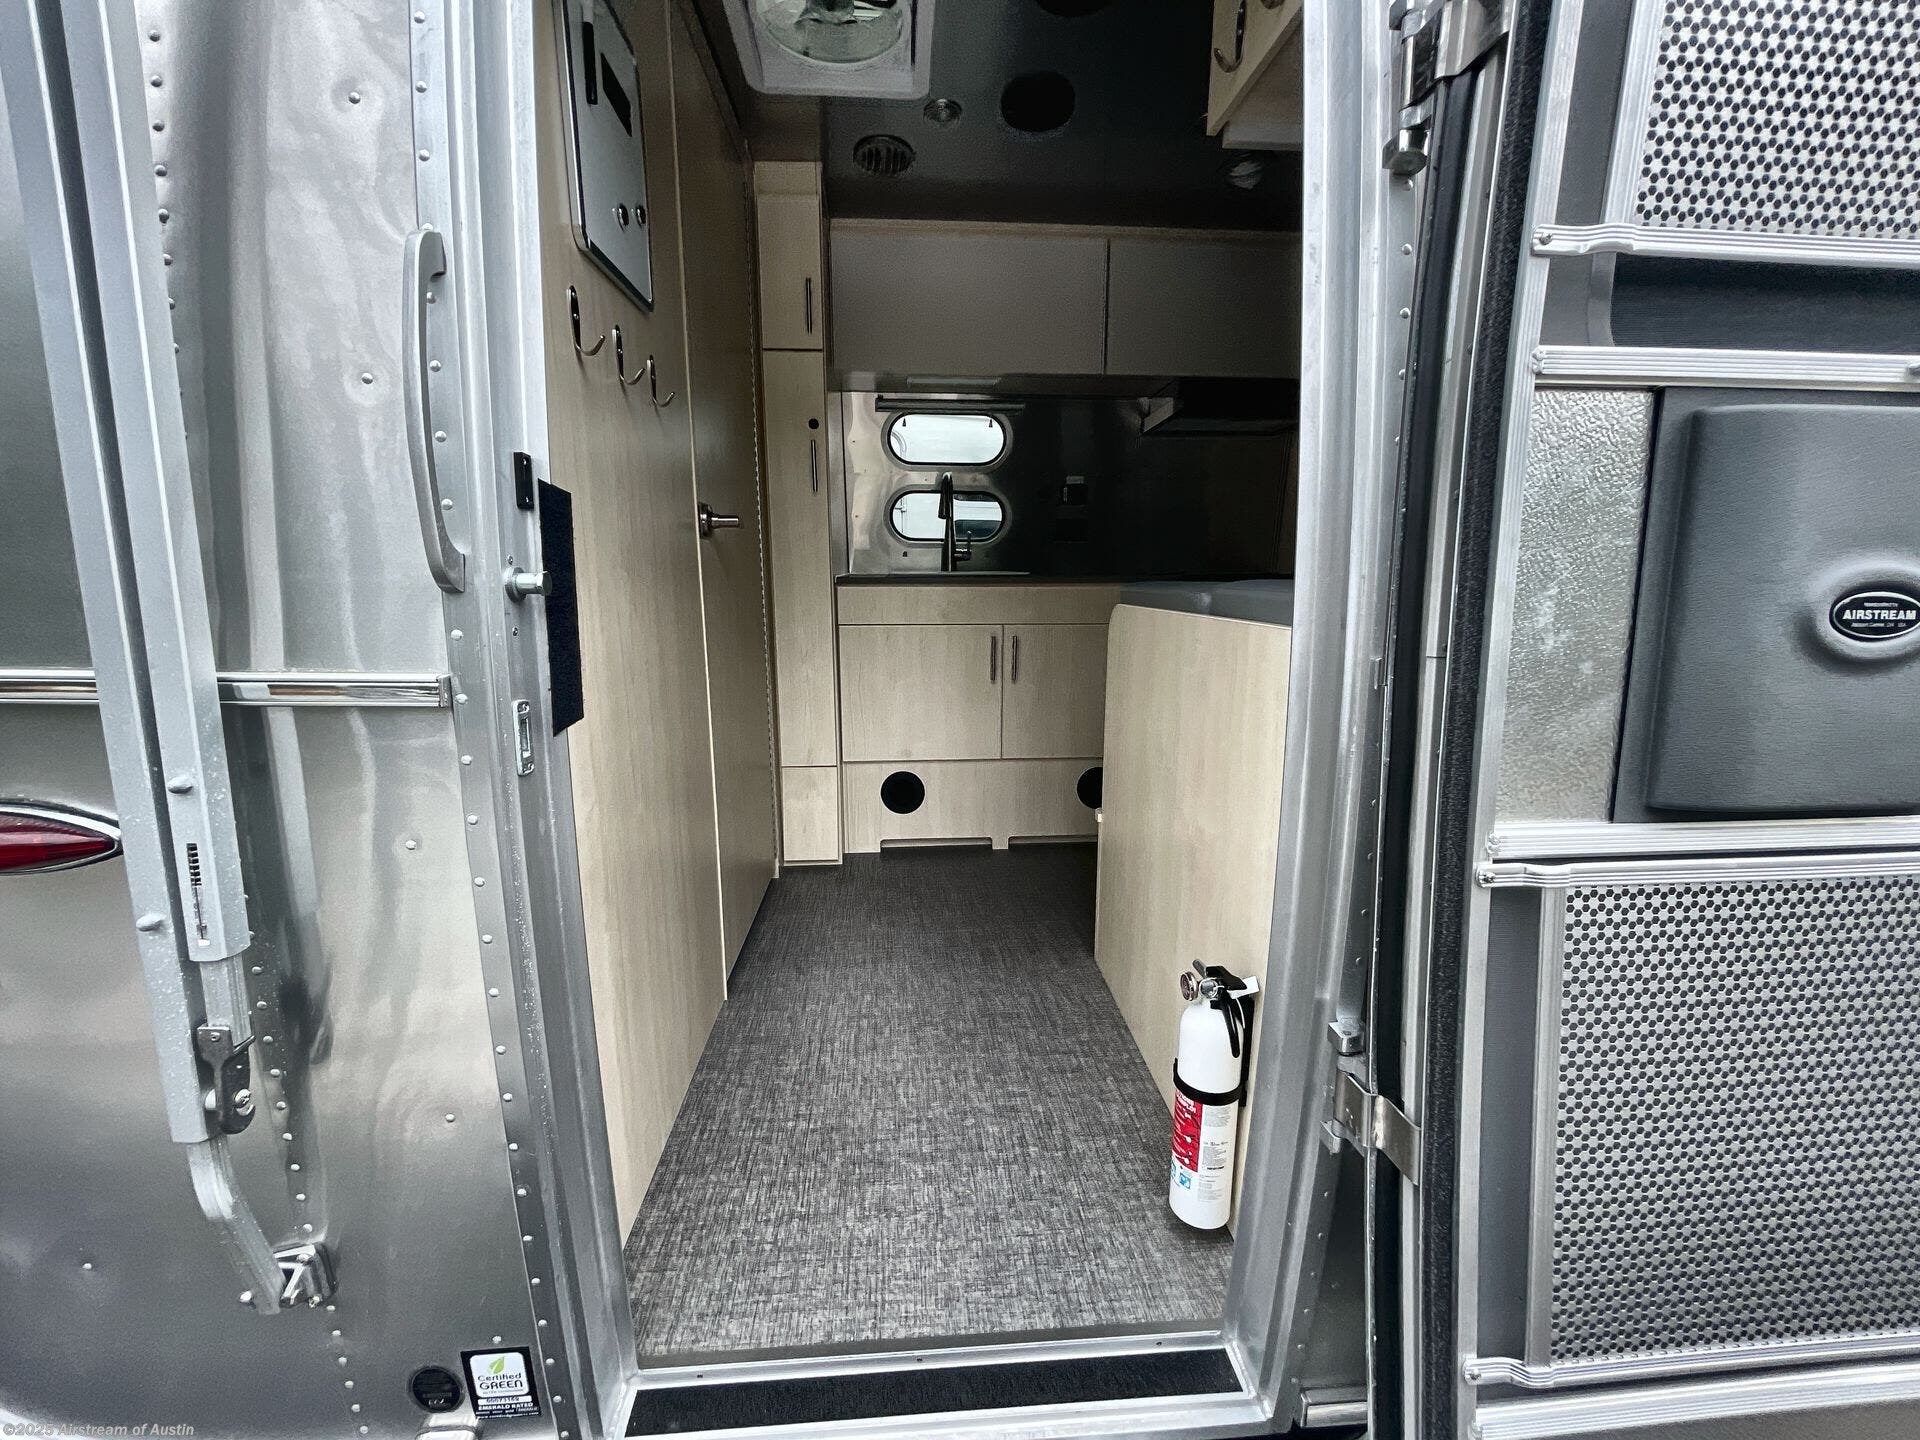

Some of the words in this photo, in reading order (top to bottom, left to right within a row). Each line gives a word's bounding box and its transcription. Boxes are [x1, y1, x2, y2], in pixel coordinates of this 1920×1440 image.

[1842, 609, 1917, 620] AIRSTREAM
[478, 1373, 522, 1381] Certified
[479, 1380, 523, 1390] GREEN
